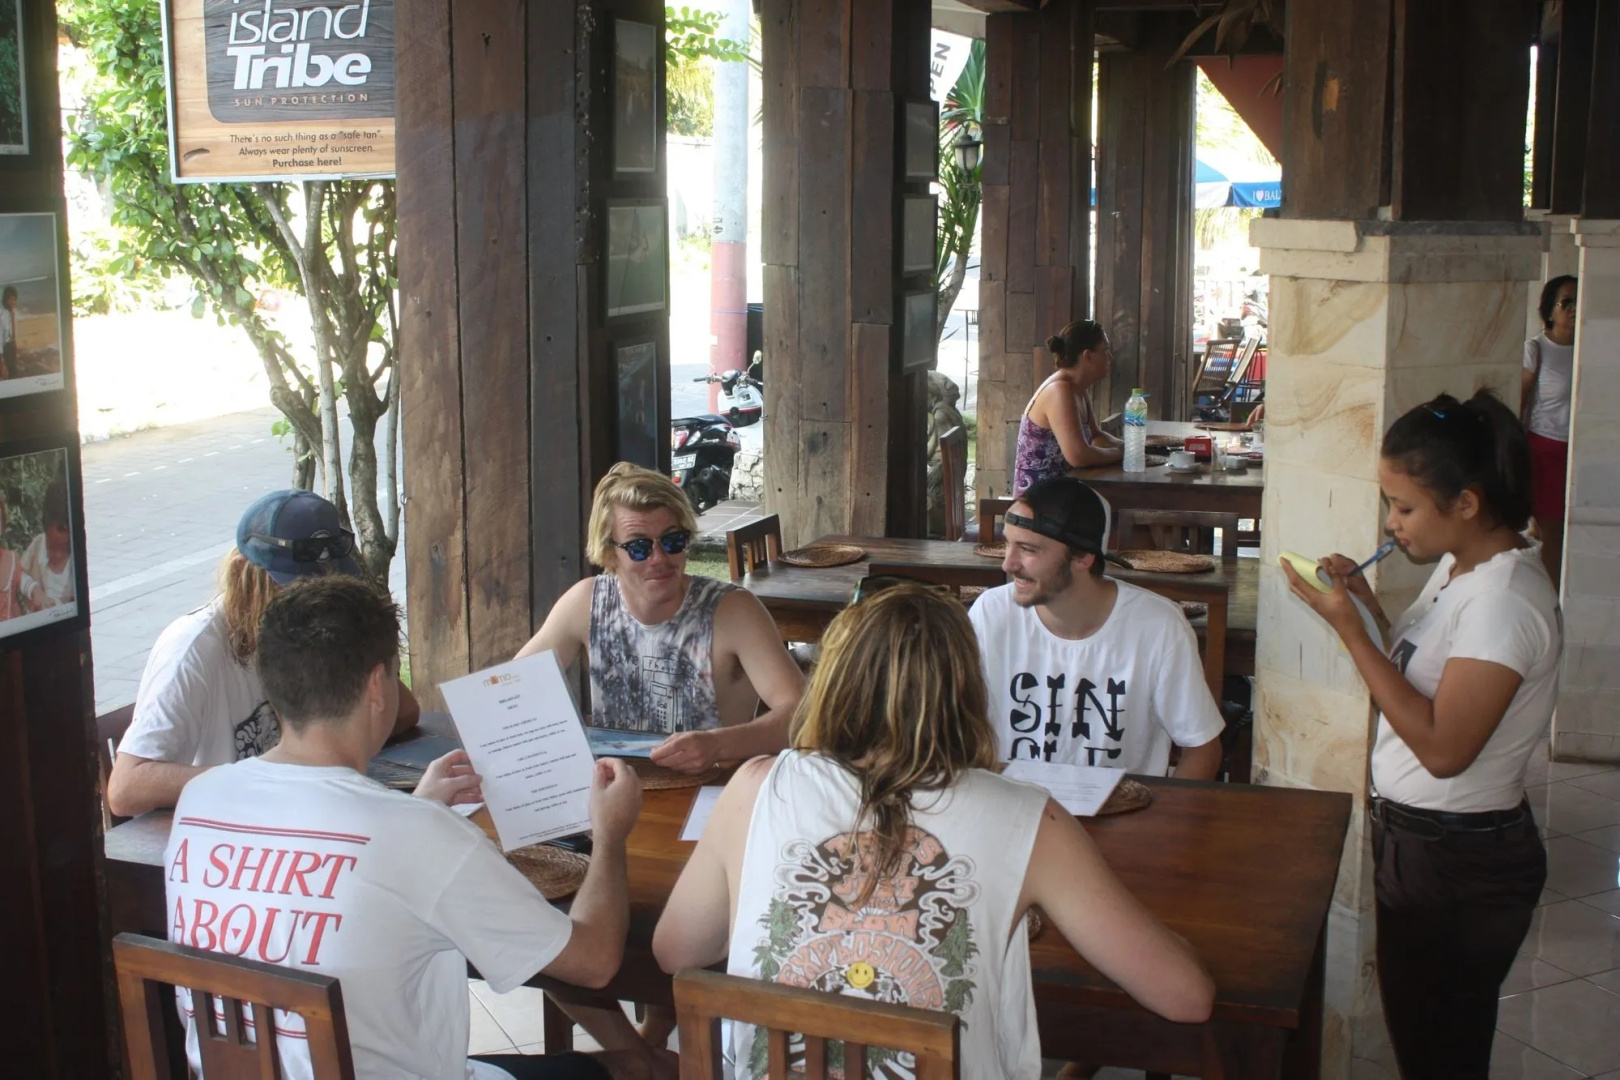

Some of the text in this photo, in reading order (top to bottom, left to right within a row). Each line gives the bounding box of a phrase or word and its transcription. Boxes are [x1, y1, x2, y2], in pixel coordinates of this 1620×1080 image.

[229, 0, 369, 44] island
[227, 43, 371, 90] Tribe
[234, 93, 368, 107] SUN PROTECTION
[230, 134, 259, 143] There's
[261, 135, 272, 143] no
[274, 132, 293, 142] such
[295, 131, 317, 143] thing
[319, 133, 329, 141] as
[239, 147, 267, 157] Always
[292, 145, 318, 157] plenty
[319, 144, 329, 153] of
[272, 157, 342, 168] Purchase here!
[1264, 190, 1281, 201] BAL
[1010, 672, 1126, 742] SIN
[169, 838, 357, 899] A SHIRT
[173, 896, 342, 965] ABOUT
